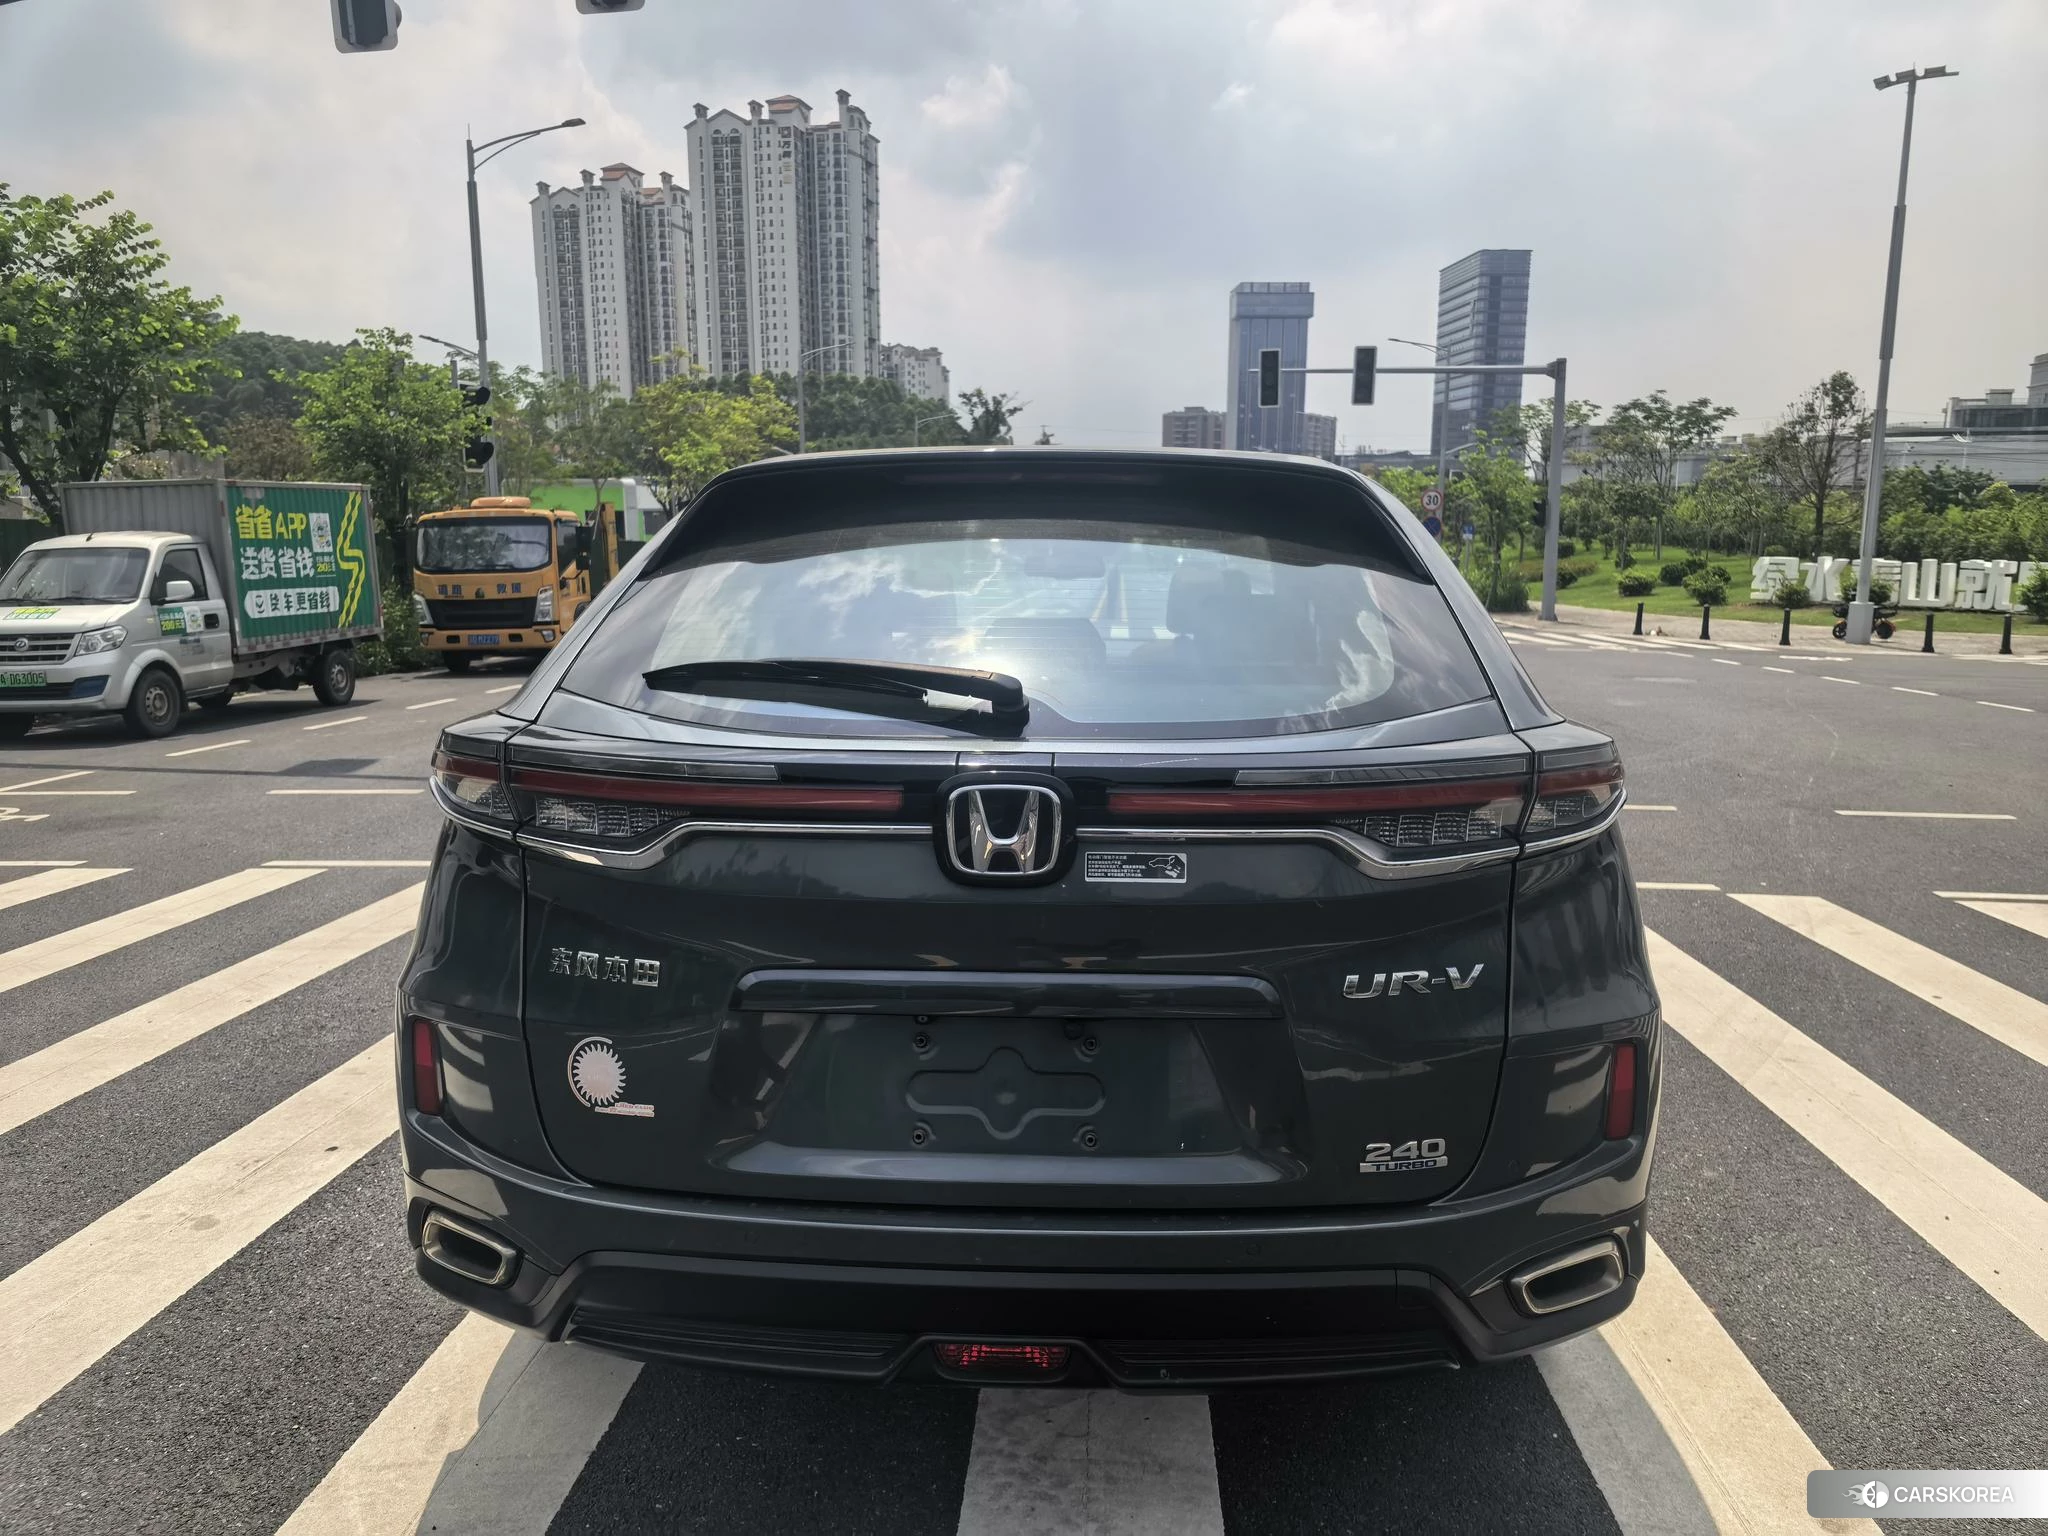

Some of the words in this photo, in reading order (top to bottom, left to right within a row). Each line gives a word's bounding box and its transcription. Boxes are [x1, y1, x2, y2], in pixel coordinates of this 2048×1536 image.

[1425, 494, 1439, 506] 30
[276, 512, 307, 539] APP
[240, 546, 315, 580] 送货省钱
[550, 947, 661, 987] 东风本田
[1343, 963, 1484, 998] UR-V
[1364, 1138, 1446, 1162] 240
[1371, 1159, 1437, 1172] TURBO
